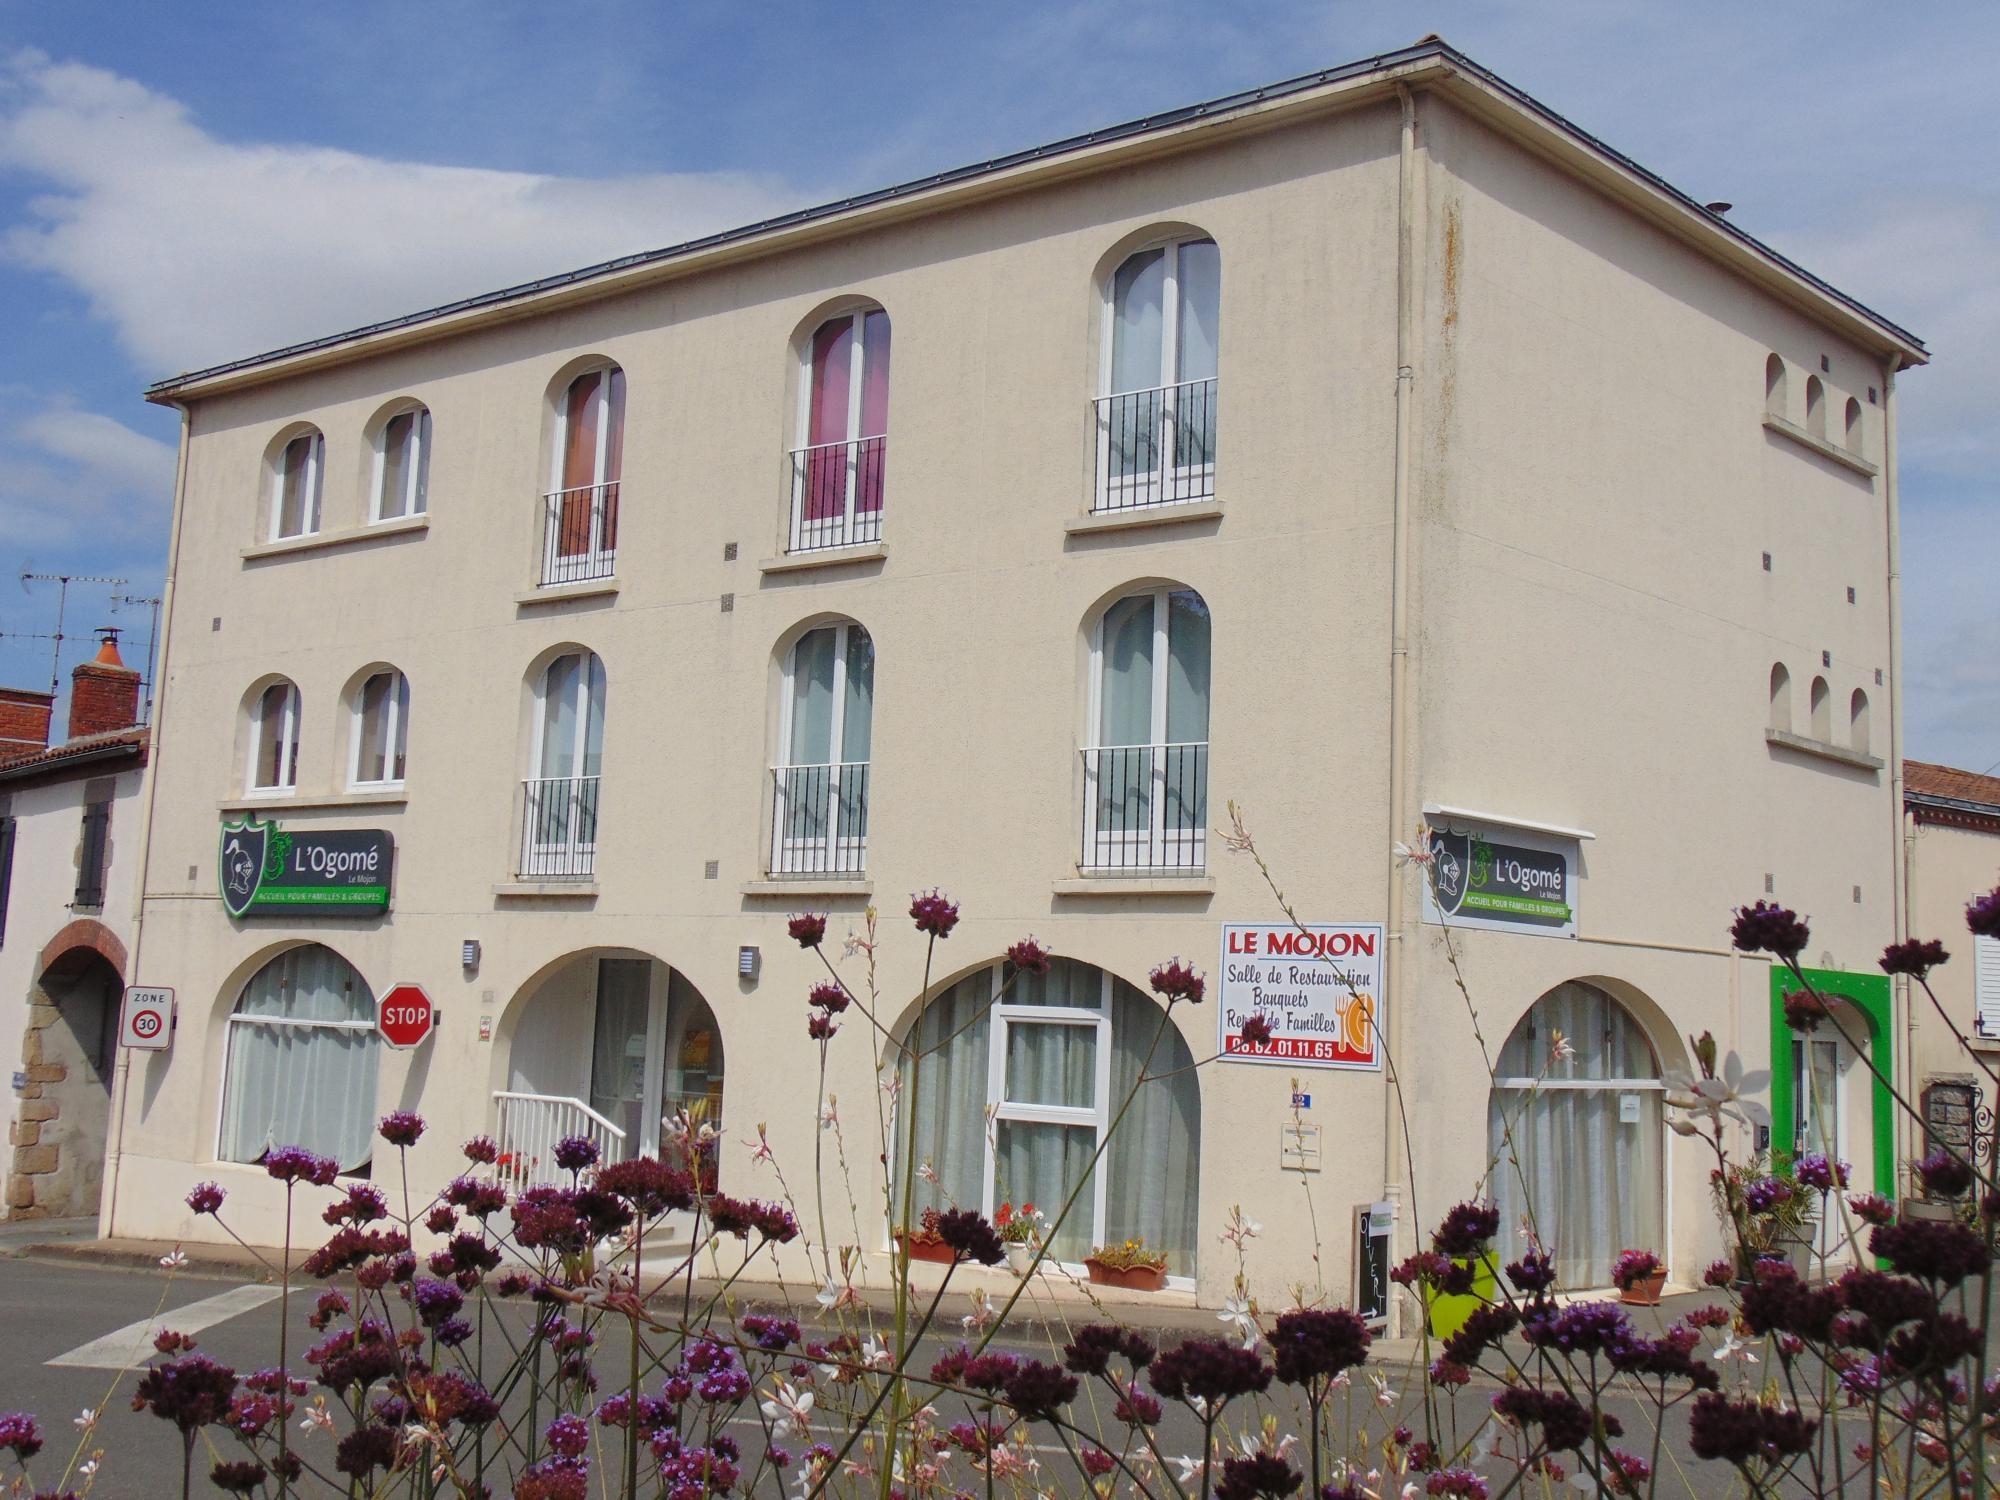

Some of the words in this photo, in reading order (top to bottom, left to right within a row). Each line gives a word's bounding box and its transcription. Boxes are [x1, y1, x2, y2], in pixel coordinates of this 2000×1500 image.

[295, 845, 378, 878] L'Ogomé
[1496, 859, 1562, 892] L'Ogomé
[288, 892, 305, 901] POUR
[308, 892, 340, 901] FAMILLES
[349, 892, 380, 901] GROUPES
[1466, 896, 1490, 906] ACCUEIL
[1492, 899, 1507, 908] POUR
[1509, 901, 1535, 911] FAMILLES
[1541, 905, 1565, 915] GROUPES
[1229, 932, 1258, 954] LE
[1267, 932, 1375, 958] MOJON
[1227, 964, 1261, 983] Salle
[1267, 966, 1282, 984] de
[134, 993, 165, 1003] ZONE
[1252, 986, 1308, 1011] Banquets
[138, 1018, 156, 1031] 30
[385, 1007, 427, 1025] STOP
[1286, 1012, 1335, 1032] Familles
